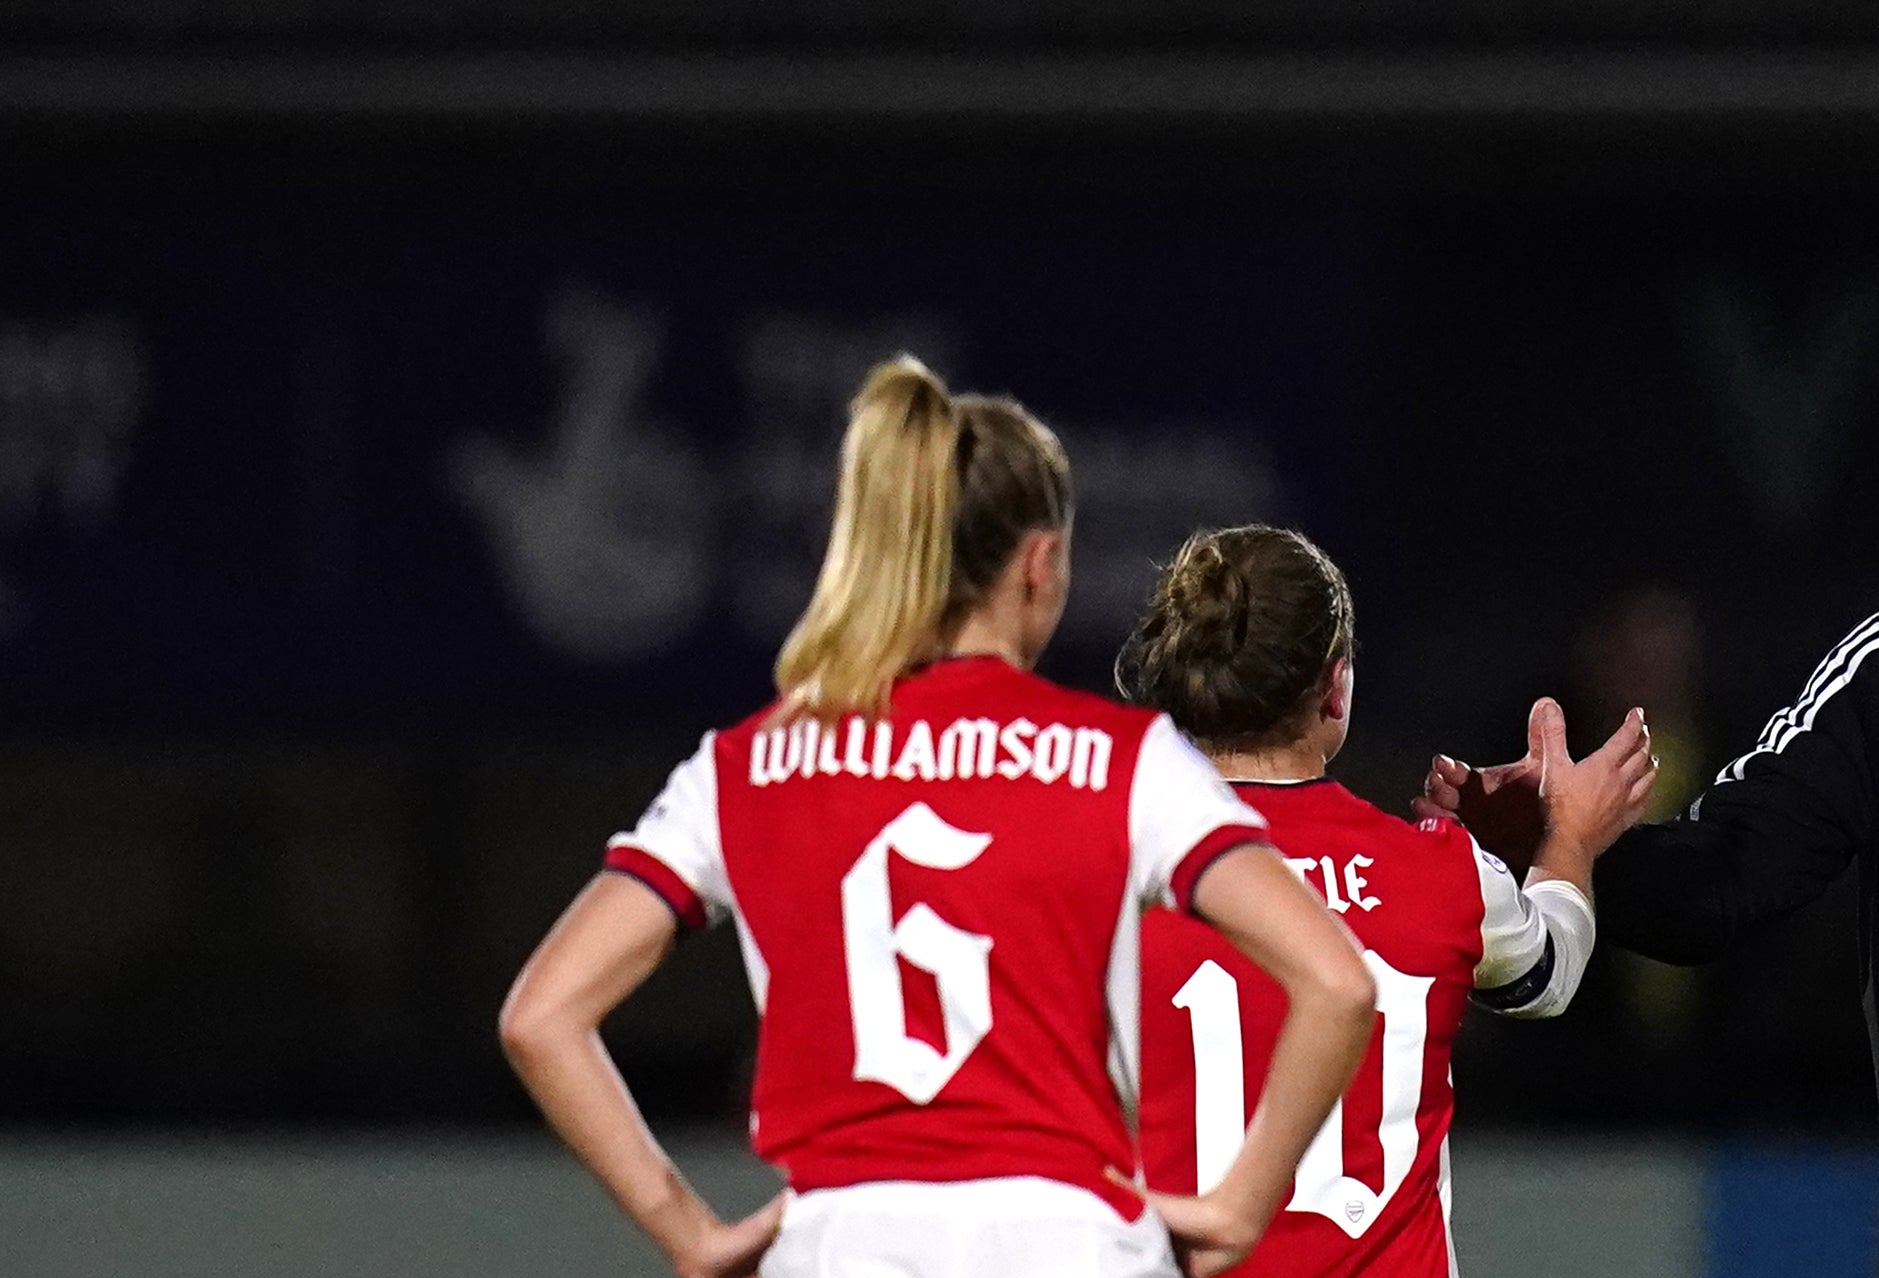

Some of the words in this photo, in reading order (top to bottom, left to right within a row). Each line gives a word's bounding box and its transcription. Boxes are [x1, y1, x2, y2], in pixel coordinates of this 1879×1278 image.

[748, 716, 1113, 791] WILLIAMSON
[840, 800, 995, 1106] 6
[1171, 948, 1437, 1240] 10
